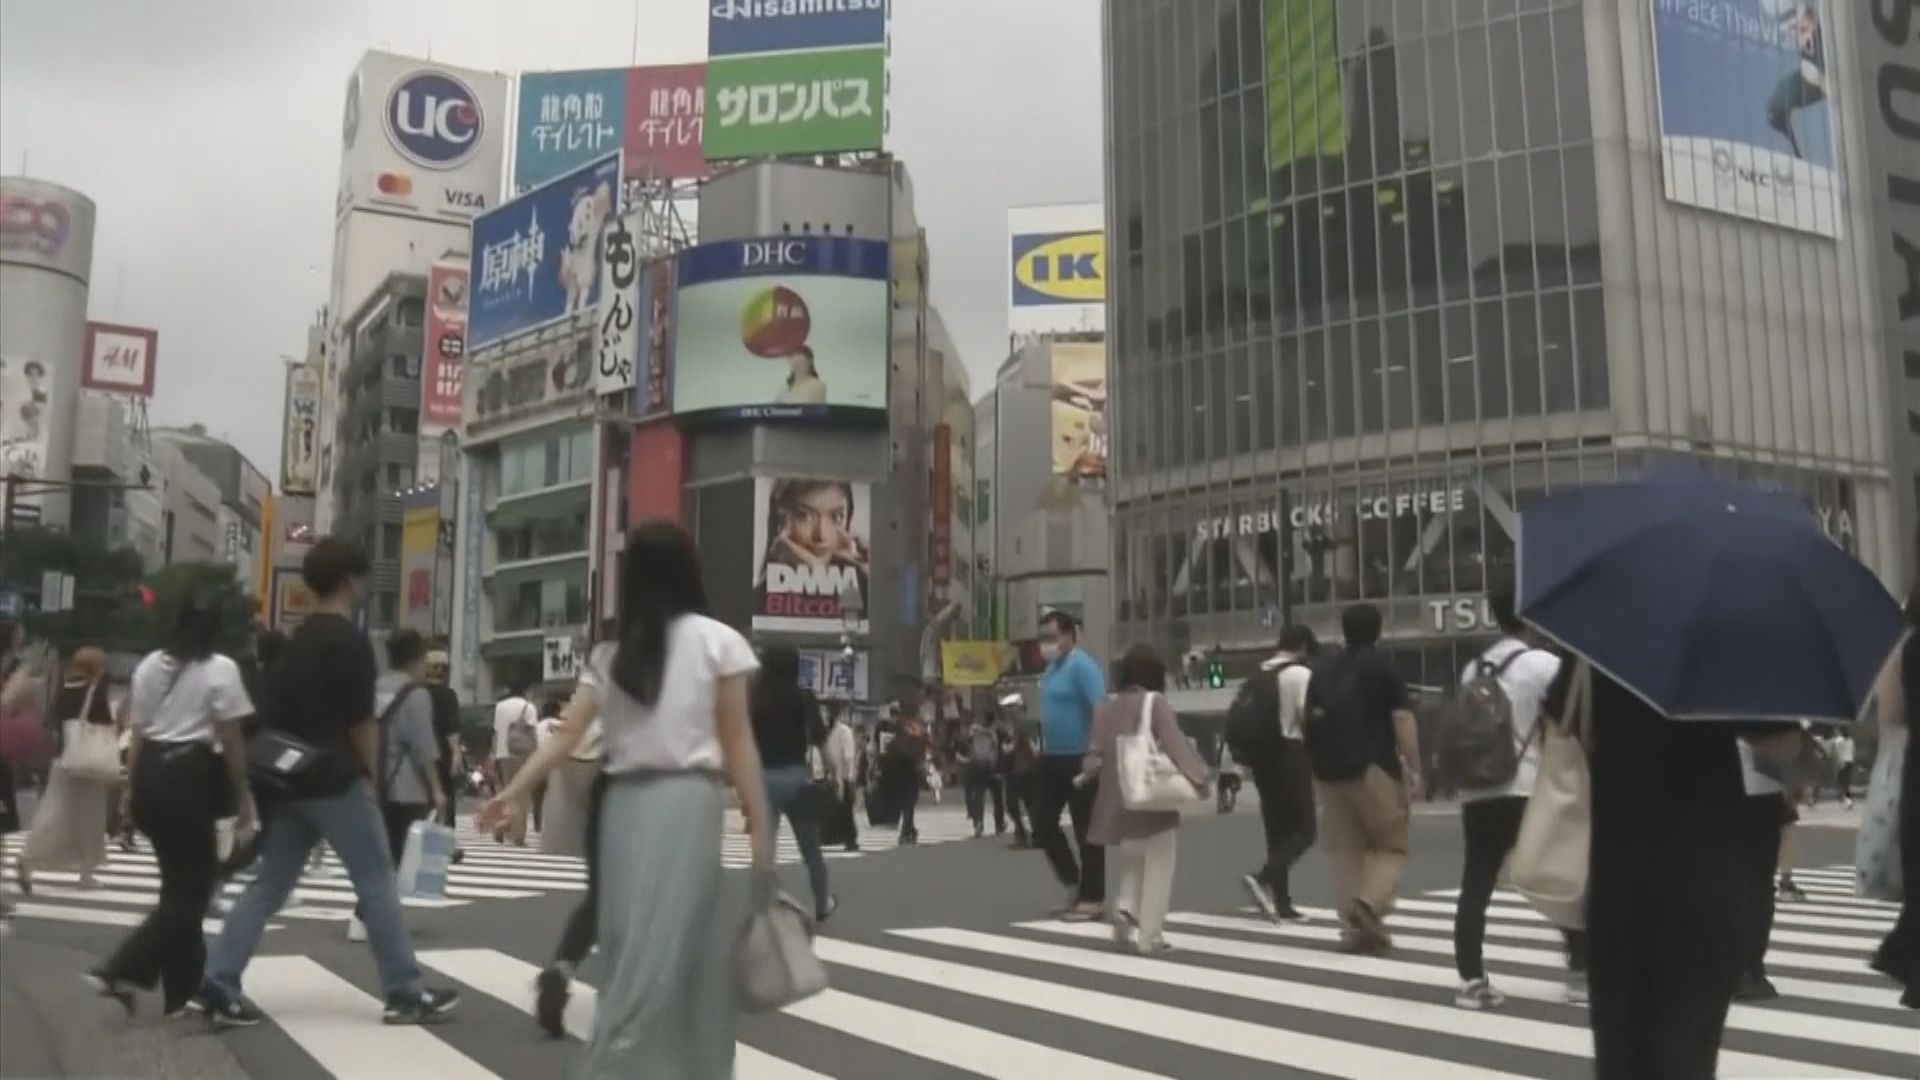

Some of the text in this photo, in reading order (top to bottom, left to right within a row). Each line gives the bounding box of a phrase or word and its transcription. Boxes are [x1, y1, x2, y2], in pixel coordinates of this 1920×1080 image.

[716, 78, 872, 128] サロンパス
[445, 189, 485, 209] VISA
[743, 240, 806, 267] DHC
[1032, 253, 1101, 283] IK
[600, 215, 635, 385] もんじゃ
[767, 564, 860, 595] DMM
